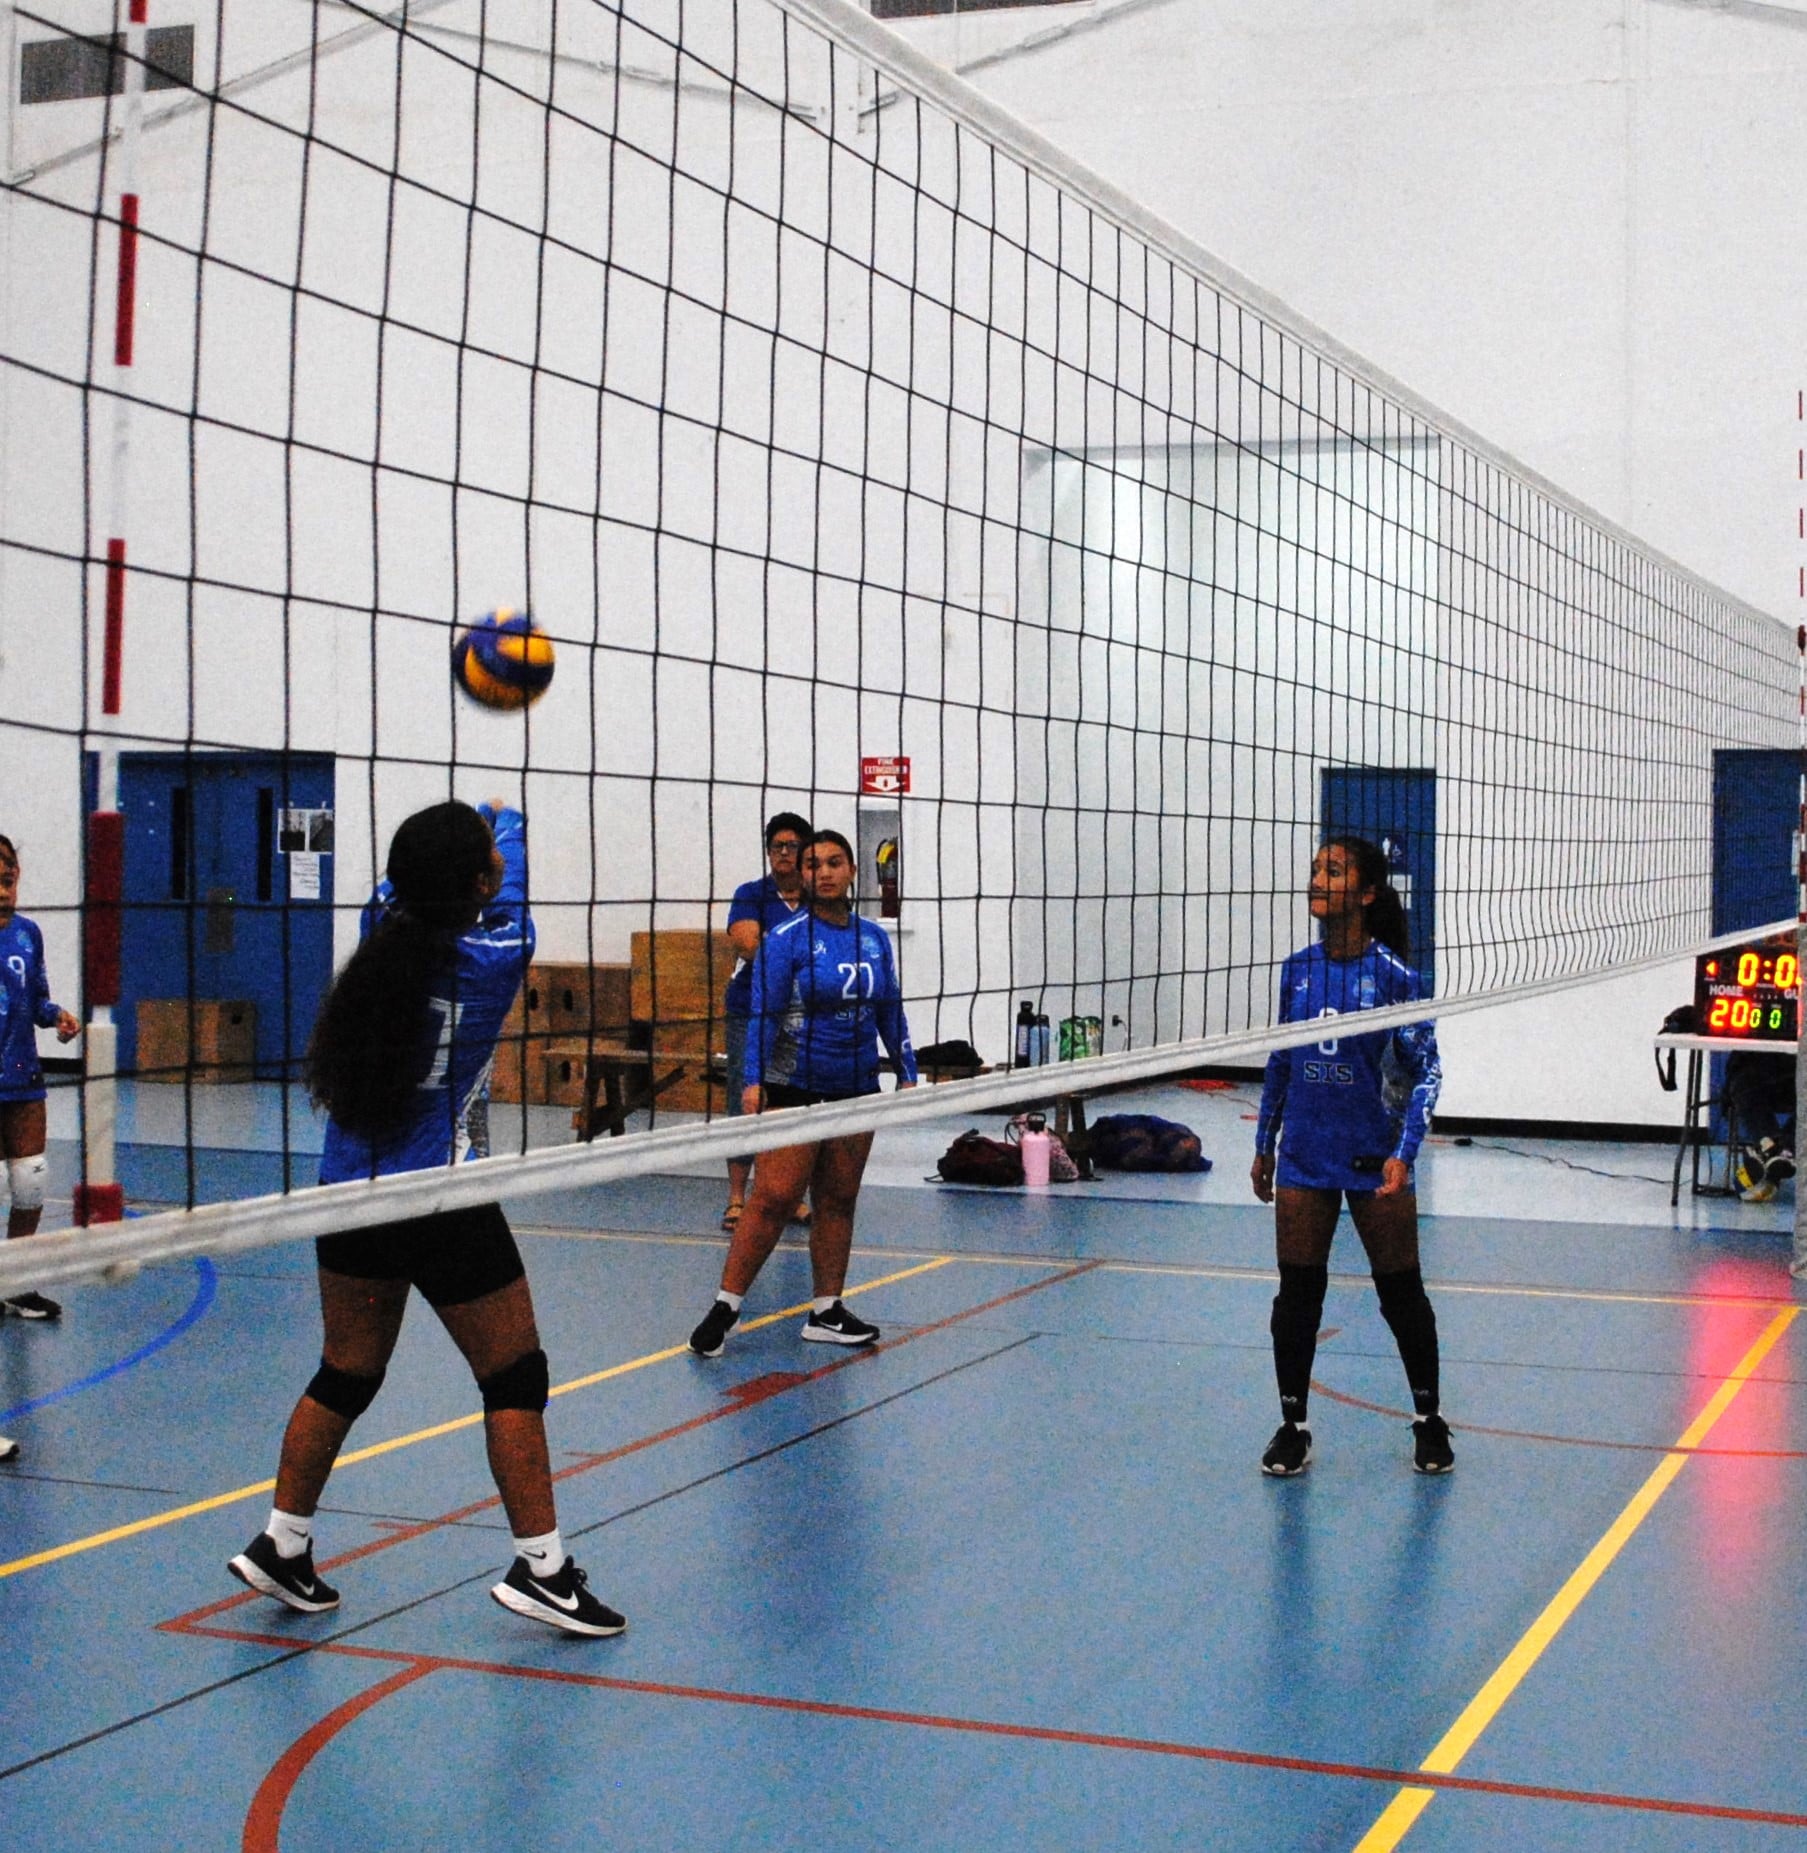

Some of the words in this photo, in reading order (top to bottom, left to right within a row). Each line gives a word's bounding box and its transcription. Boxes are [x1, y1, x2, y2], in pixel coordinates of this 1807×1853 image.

[864, 765, 908, 775] EXTINGUISHR
[7, 955, 26, 989] 9
[837, 962, 875, 1000] 27
[1709, 984, 1745, 998] HOME
[1711, 999, 1749, 1029] 20
[1769, 1009, 1782, 1030] 0
[1303, 1060, 1354, 1085] SIS
